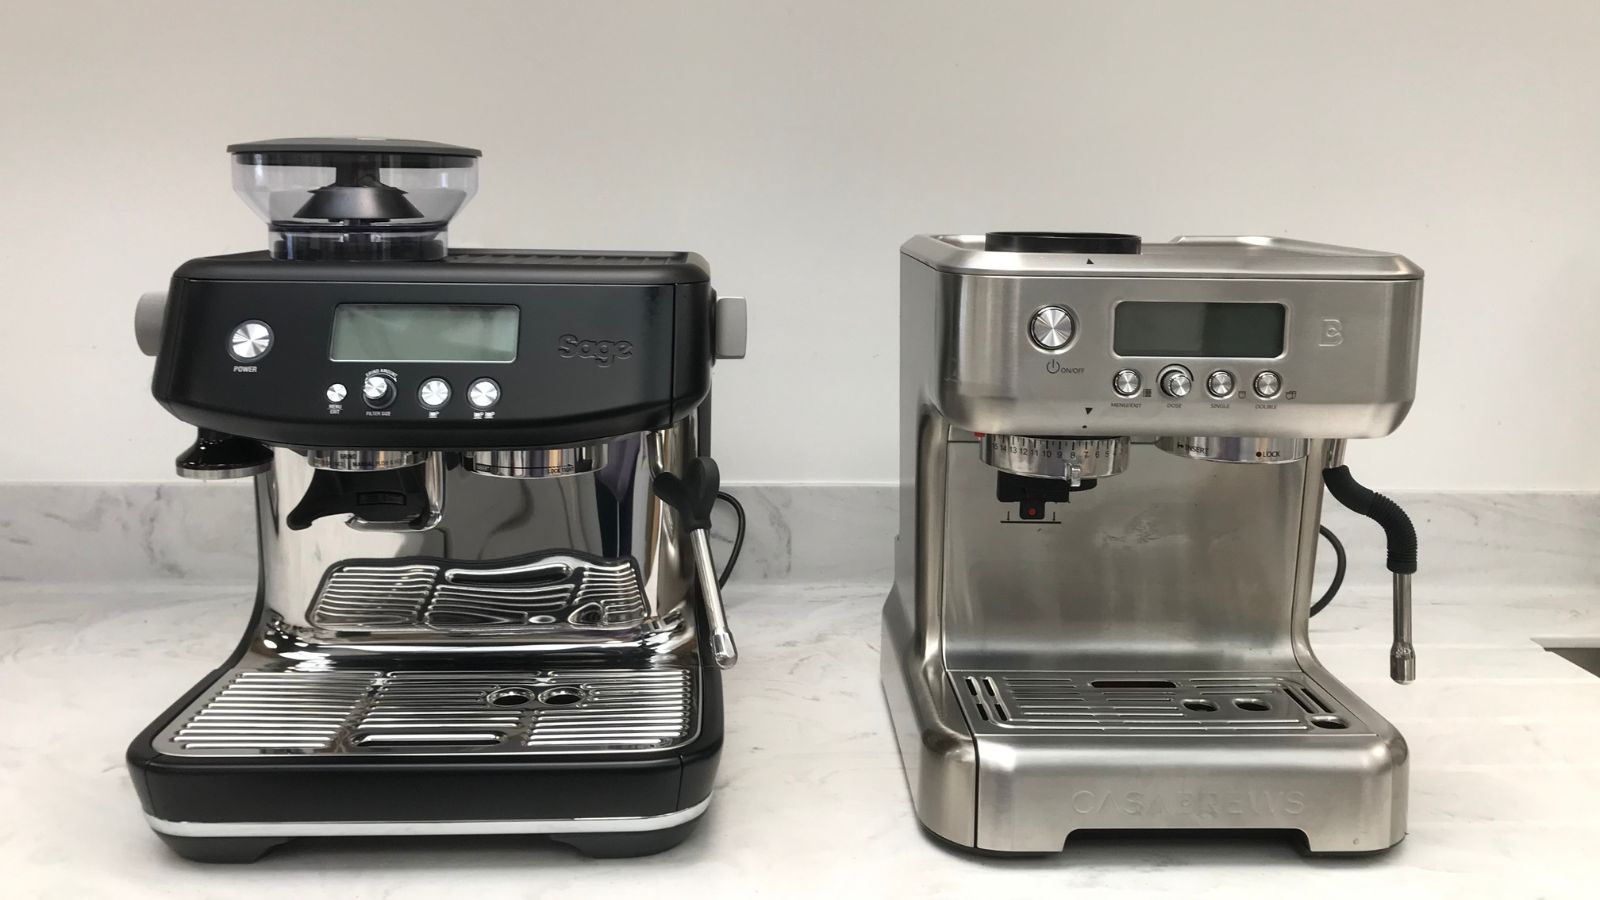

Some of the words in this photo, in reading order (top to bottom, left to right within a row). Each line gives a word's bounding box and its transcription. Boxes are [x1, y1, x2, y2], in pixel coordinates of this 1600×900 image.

[559, 334, 632, 368] Sage
[1010, 446, 1018, 454] 13
[1020, 448, 1028, 456] 12
[1030, 449, 1039, 457] 11
[1043, 450, 1052, 458] 10
[1057, 451, 1063, 459] 9
[1070, 451, 1076, 459] 8
[1185, 443, 1209, 456] INSERT
[548, 466, 561, 474] LOCK
